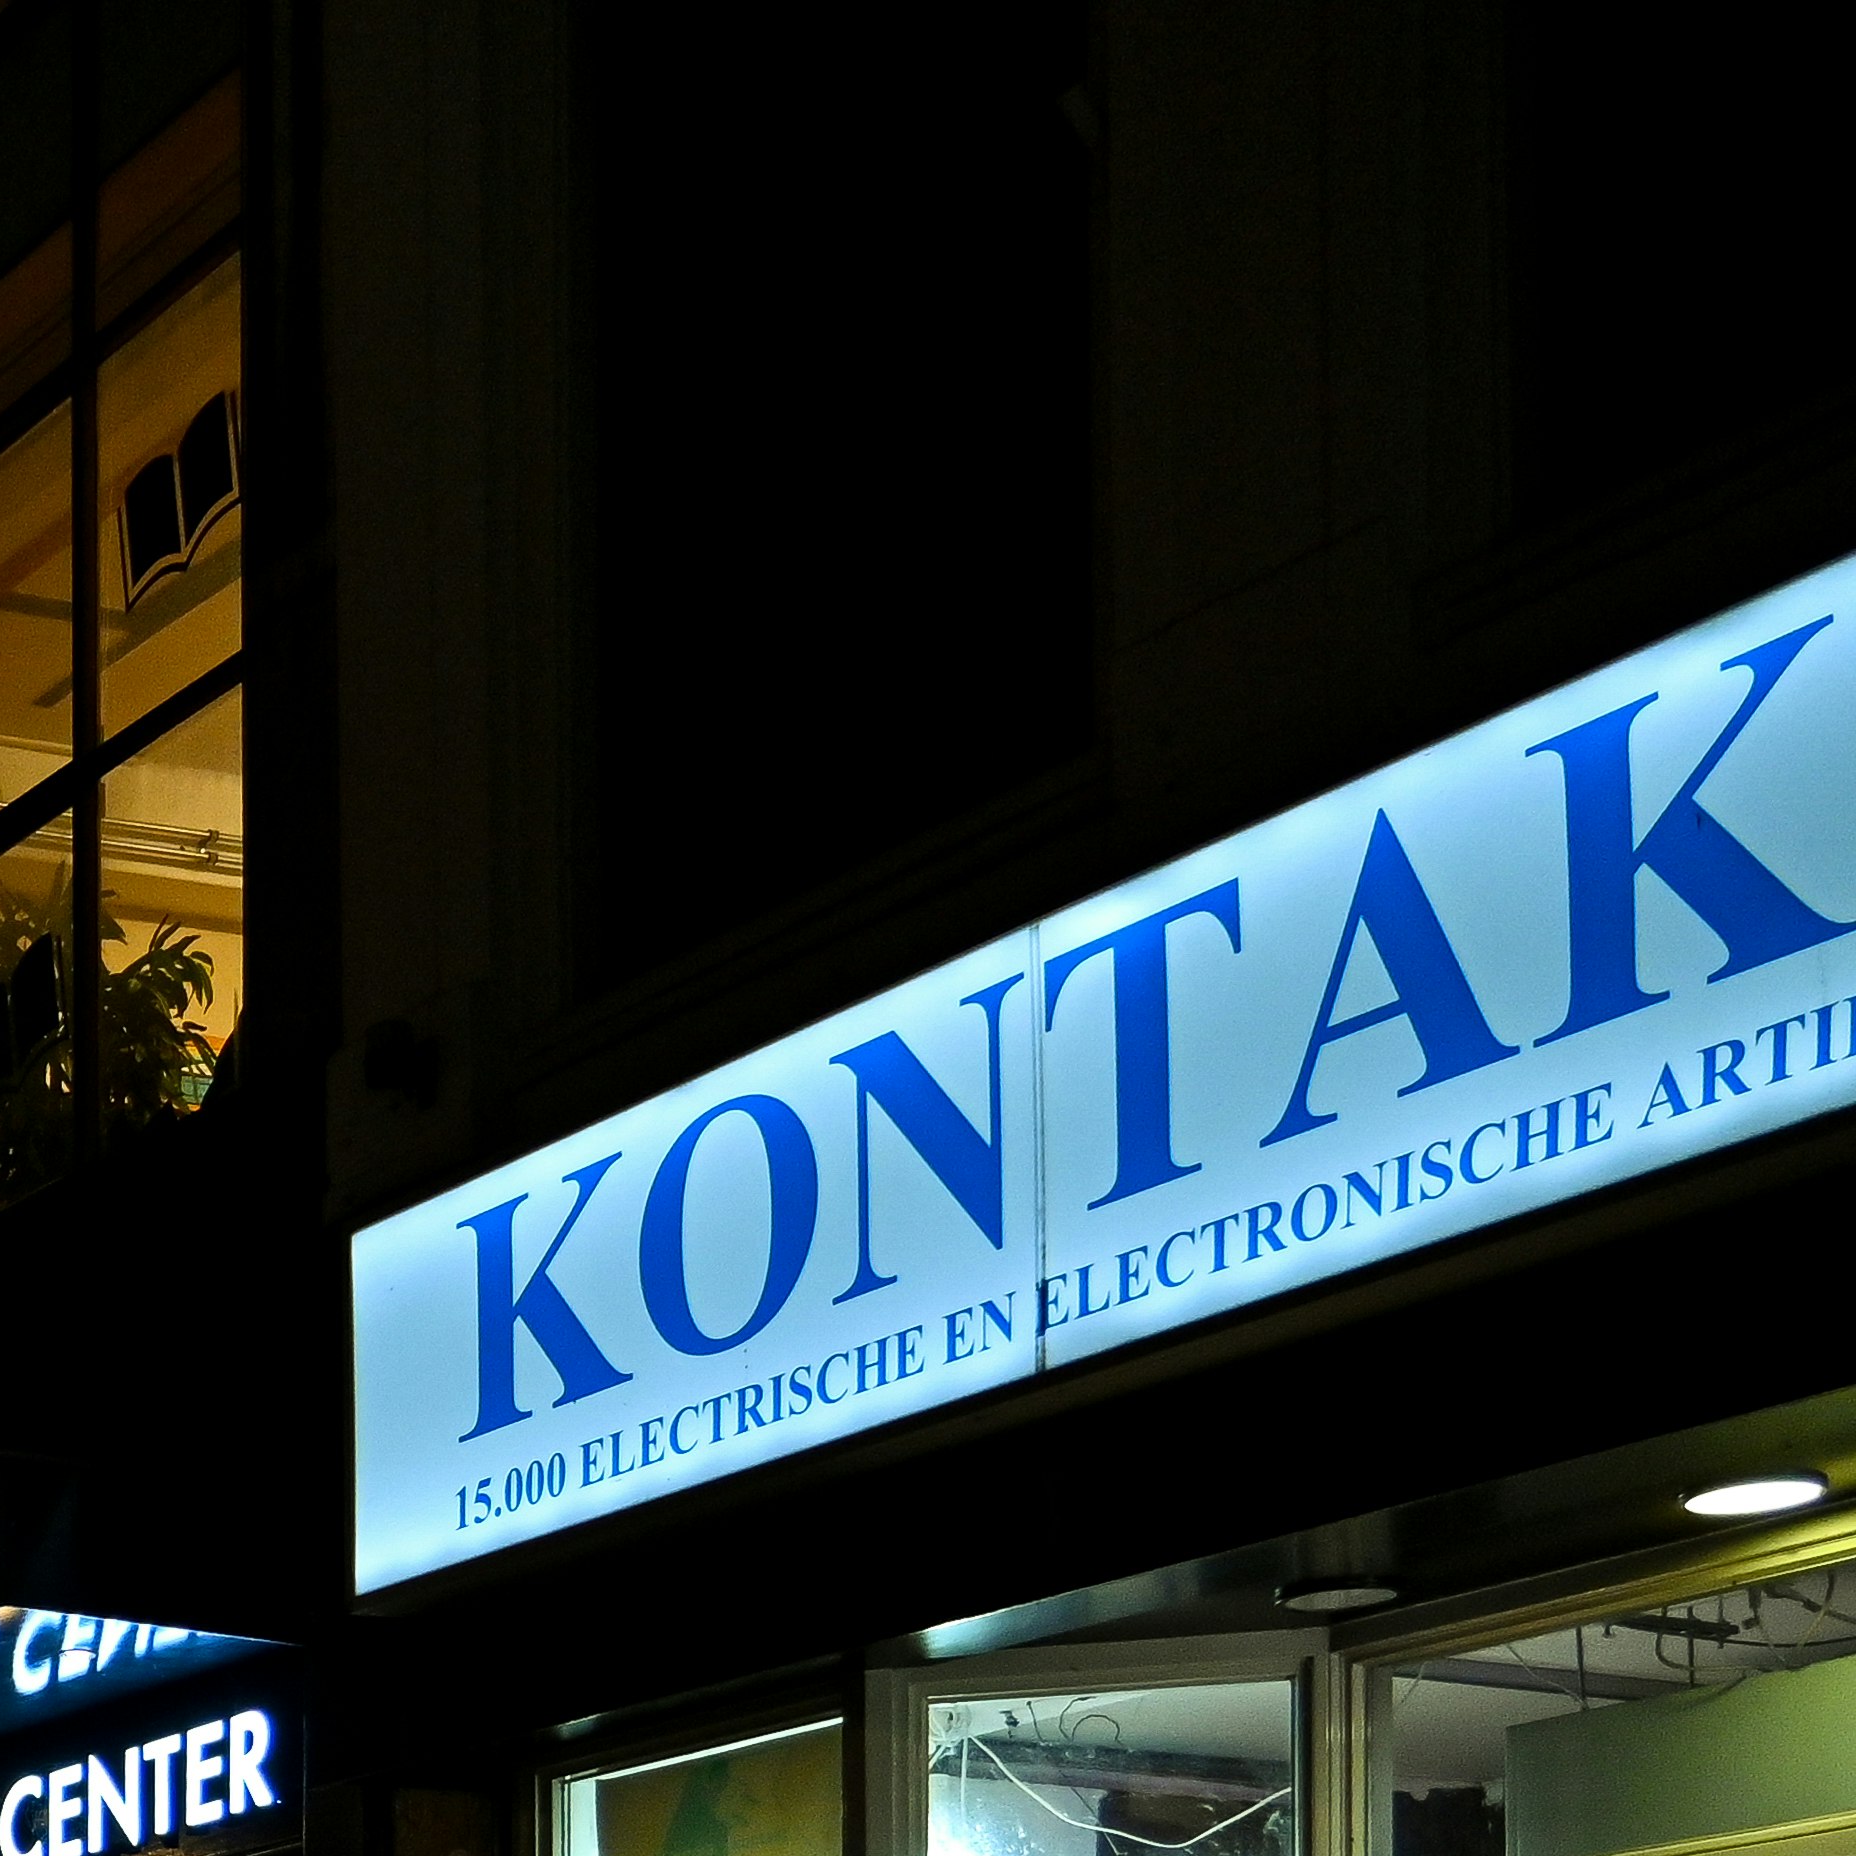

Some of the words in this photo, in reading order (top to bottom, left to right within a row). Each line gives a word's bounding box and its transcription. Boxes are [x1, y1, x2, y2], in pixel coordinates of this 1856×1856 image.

[455, 1451, 567, 1532] 15.000
[579, 1324, 926, 1489] ELECTRISCHE
[943, 1290, 1017, 1365] EN
[1036, 1081, 1614, 1340] ELECTRONISCHE
